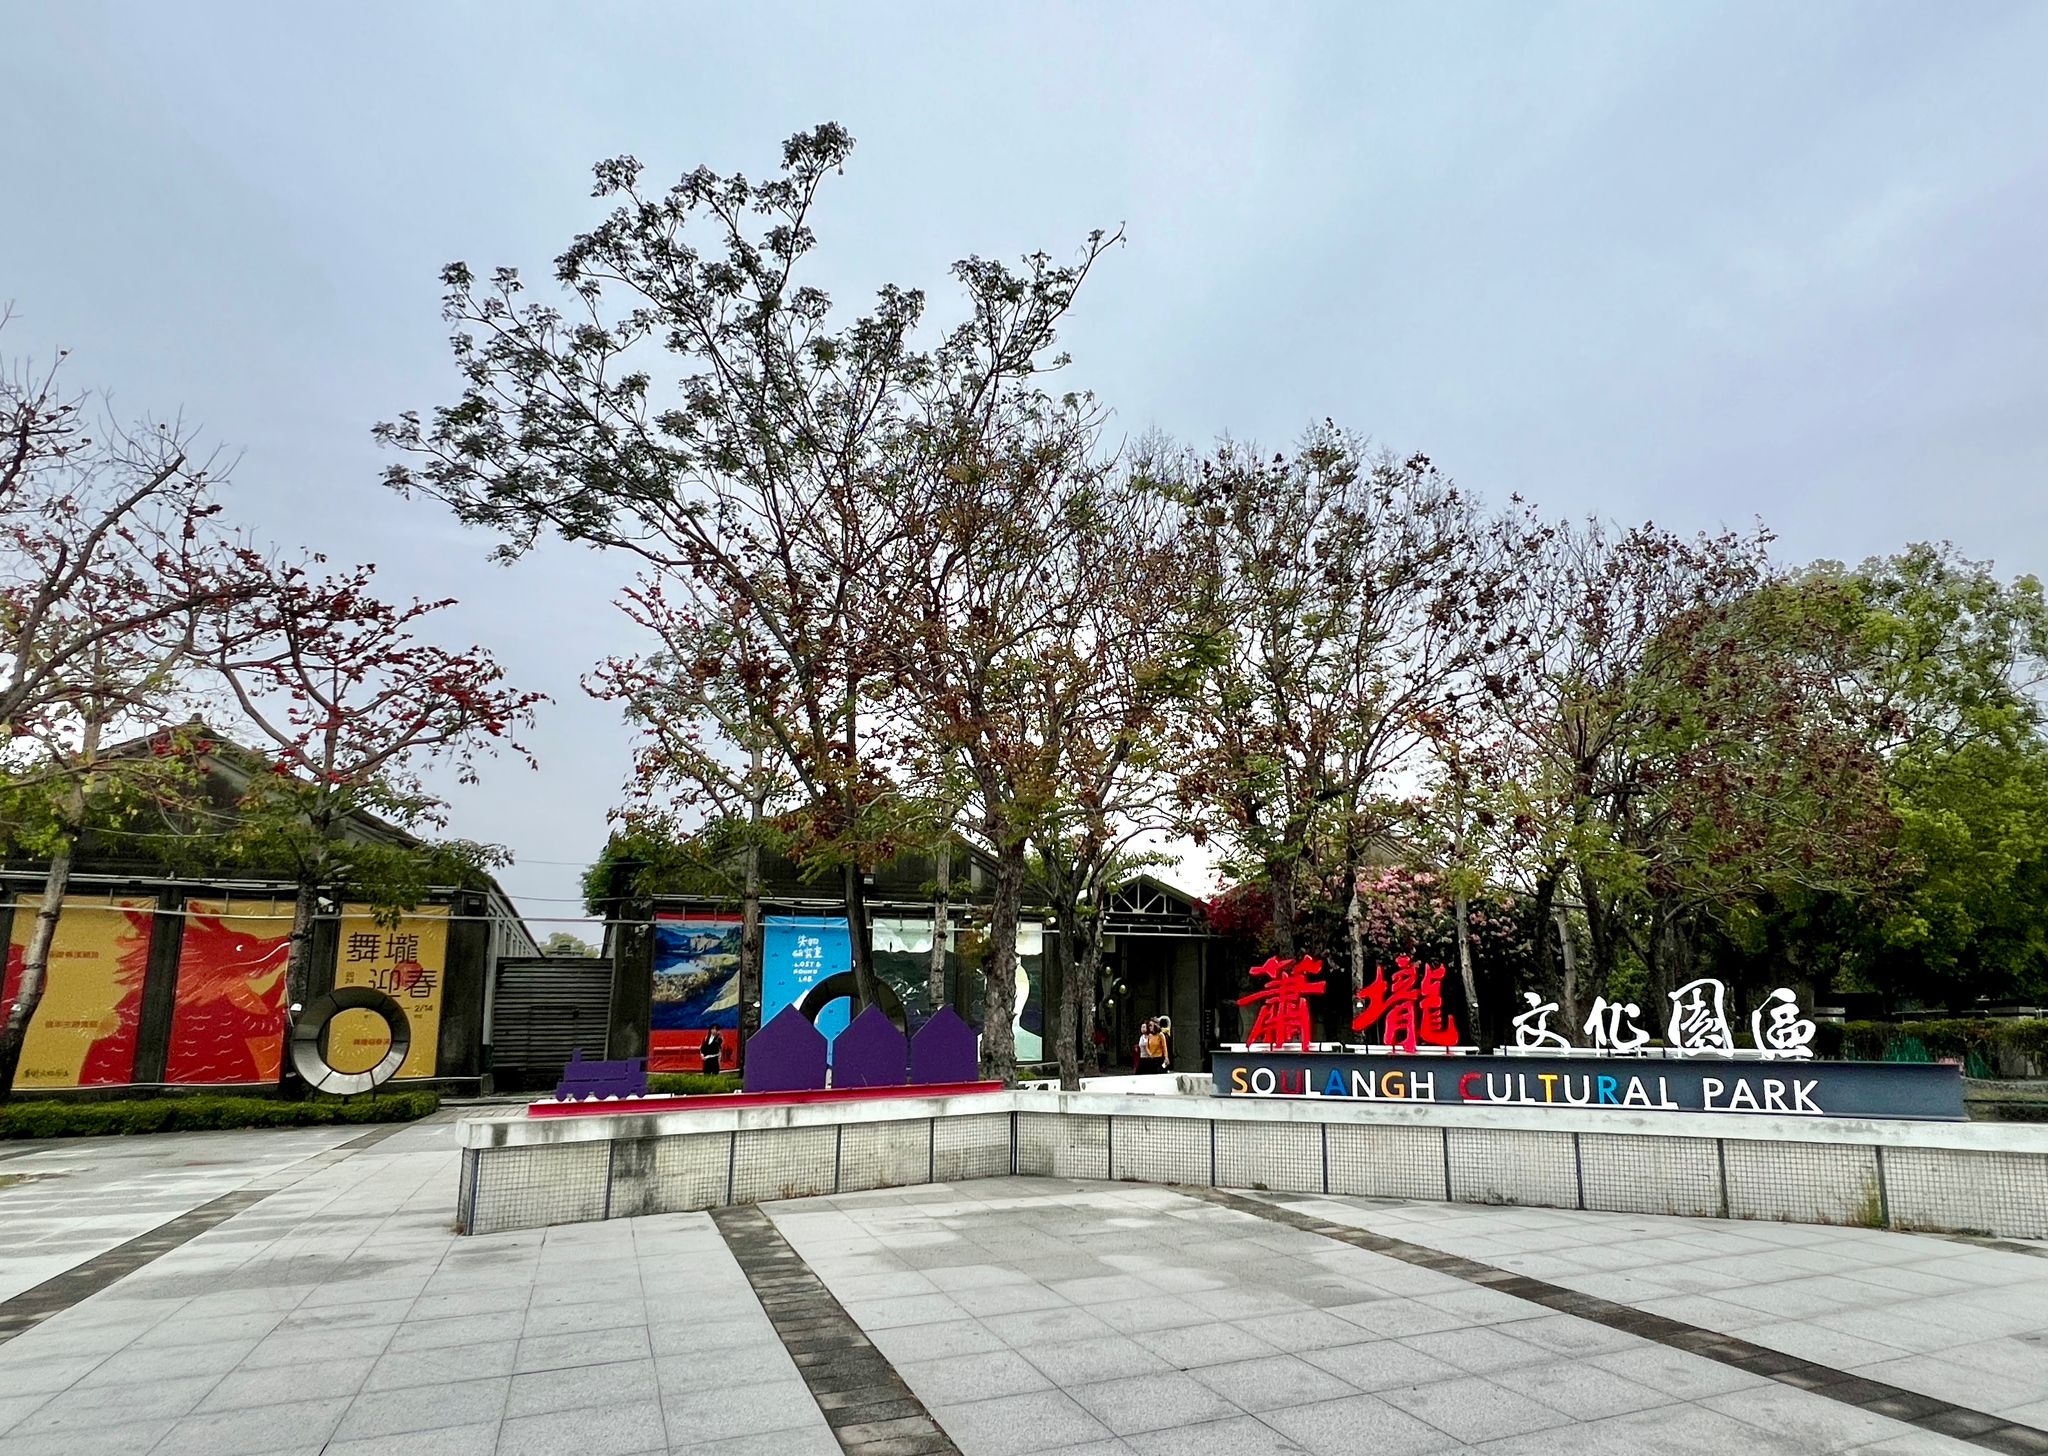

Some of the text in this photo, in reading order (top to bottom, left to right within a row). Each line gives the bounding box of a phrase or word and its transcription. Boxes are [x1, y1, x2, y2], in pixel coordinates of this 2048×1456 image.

[346, 932, 419, 964] 舞壠
[368, 969, 437, 998] 迎春
[1231, 1067, 1823, 1113] SOULANGH CULTURAL PARK
